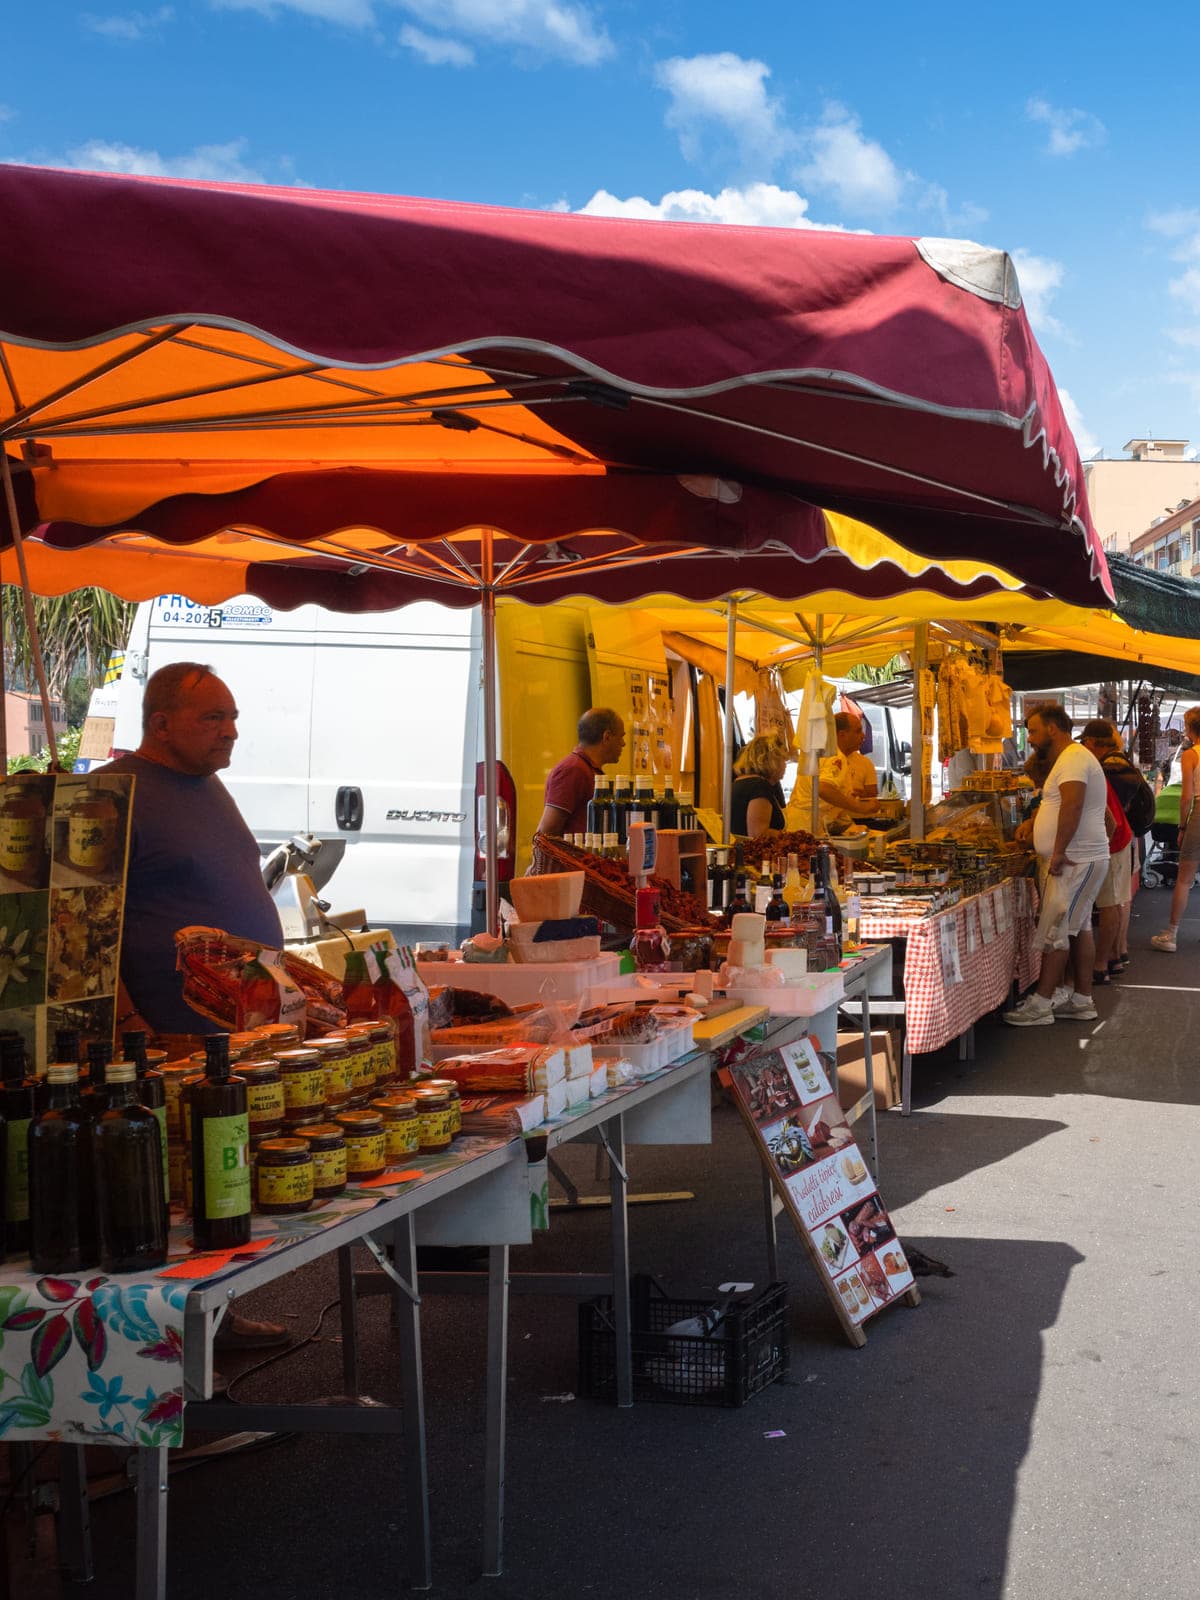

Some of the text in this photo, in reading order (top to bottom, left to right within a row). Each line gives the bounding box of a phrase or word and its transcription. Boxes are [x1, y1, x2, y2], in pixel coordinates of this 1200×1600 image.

[222, 605, 273, 616] ROMBO
[386, 809, 467, 823] DUCATO
[808, 1182, 843, 1223] calabresi
